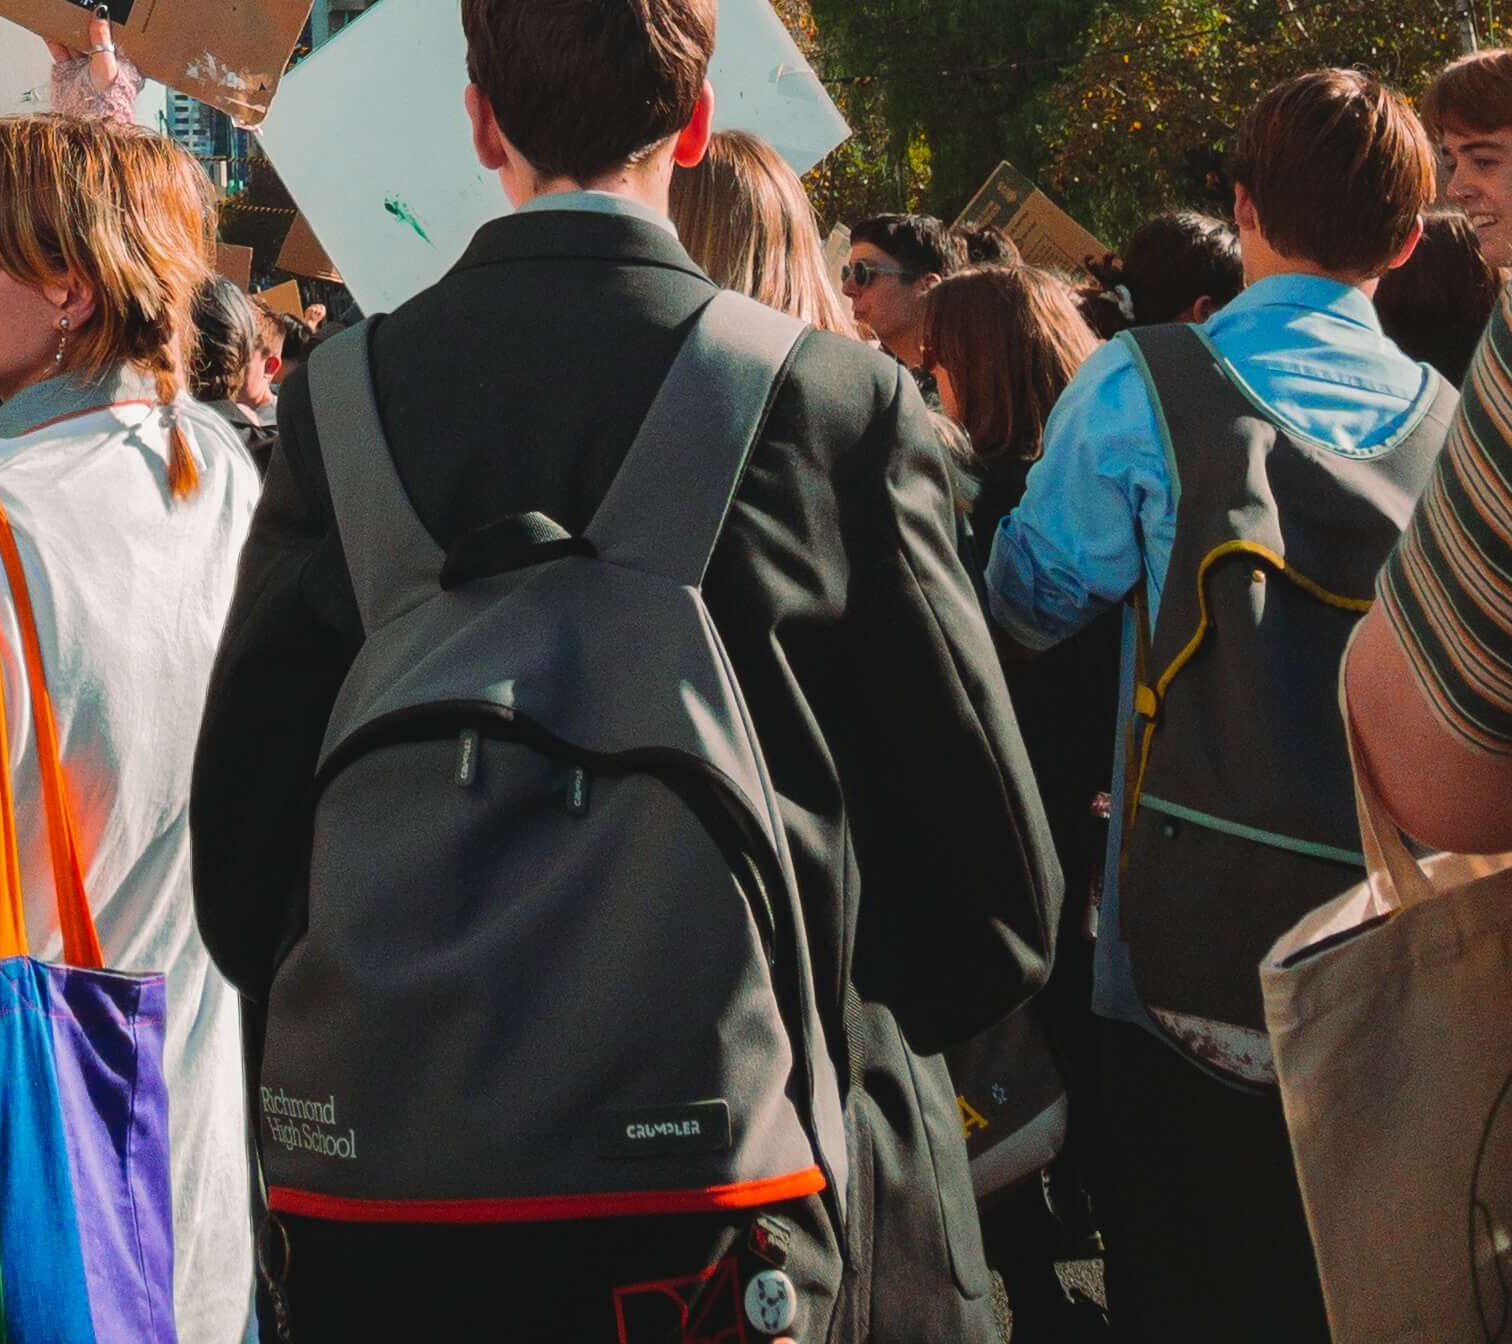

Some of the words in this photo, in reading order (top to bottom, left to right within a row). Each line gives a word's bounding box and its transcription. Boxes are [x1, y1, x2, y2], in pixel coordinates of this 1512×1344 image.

[260, 1086, 336, 1125] Richmond
[266, 1115, 303, 1151] High
[301, 1123, 357, 1159] School
[626, 1119, 701, 1140] CRUMPLER
